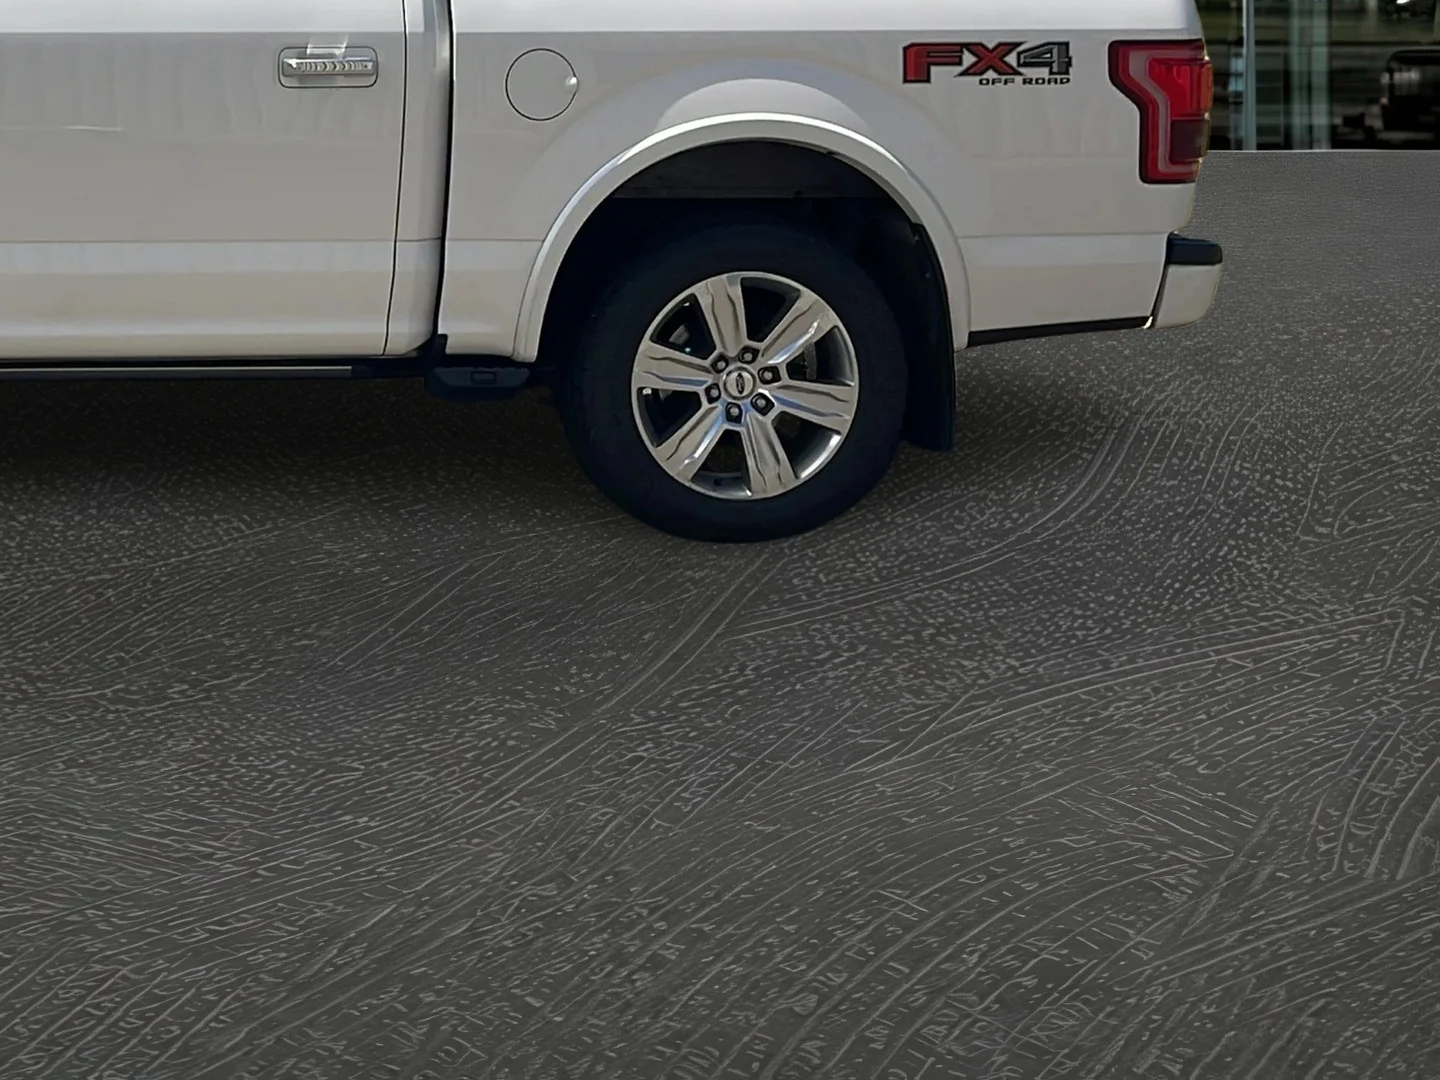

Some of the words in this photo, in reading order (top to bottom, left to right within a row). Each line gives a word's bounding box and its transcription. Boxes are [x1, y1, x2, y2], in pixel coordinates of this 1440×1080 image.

[902, 41, 1072, 84] FX4
[979, 78, 1015, 86] OFF
[1022, 77, 1071, 85] ROAD
